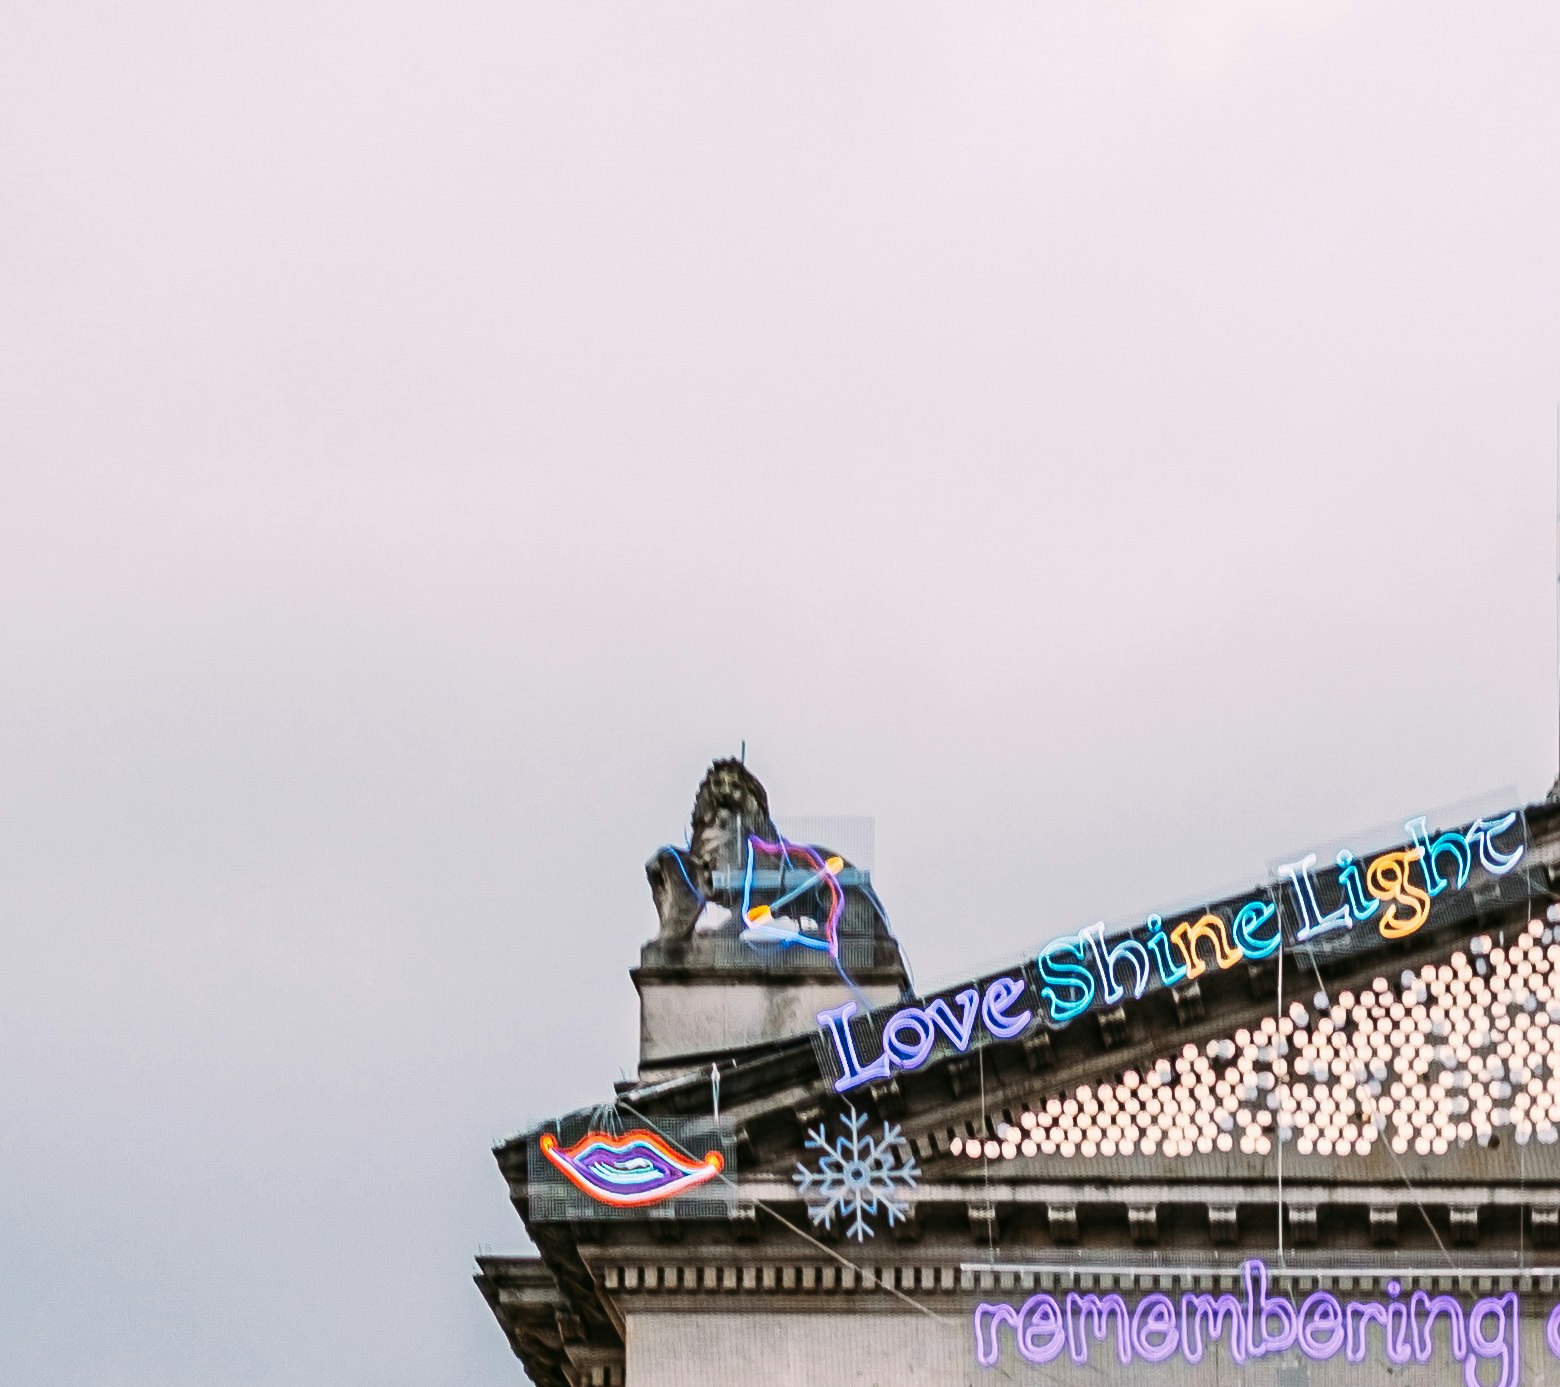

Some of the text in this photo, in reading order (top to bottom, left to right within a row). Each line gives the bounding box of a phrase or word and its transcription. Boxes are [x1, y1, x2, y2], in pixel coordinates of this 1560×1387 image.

[817, 814, 1525, 1093] Love Shine Light
